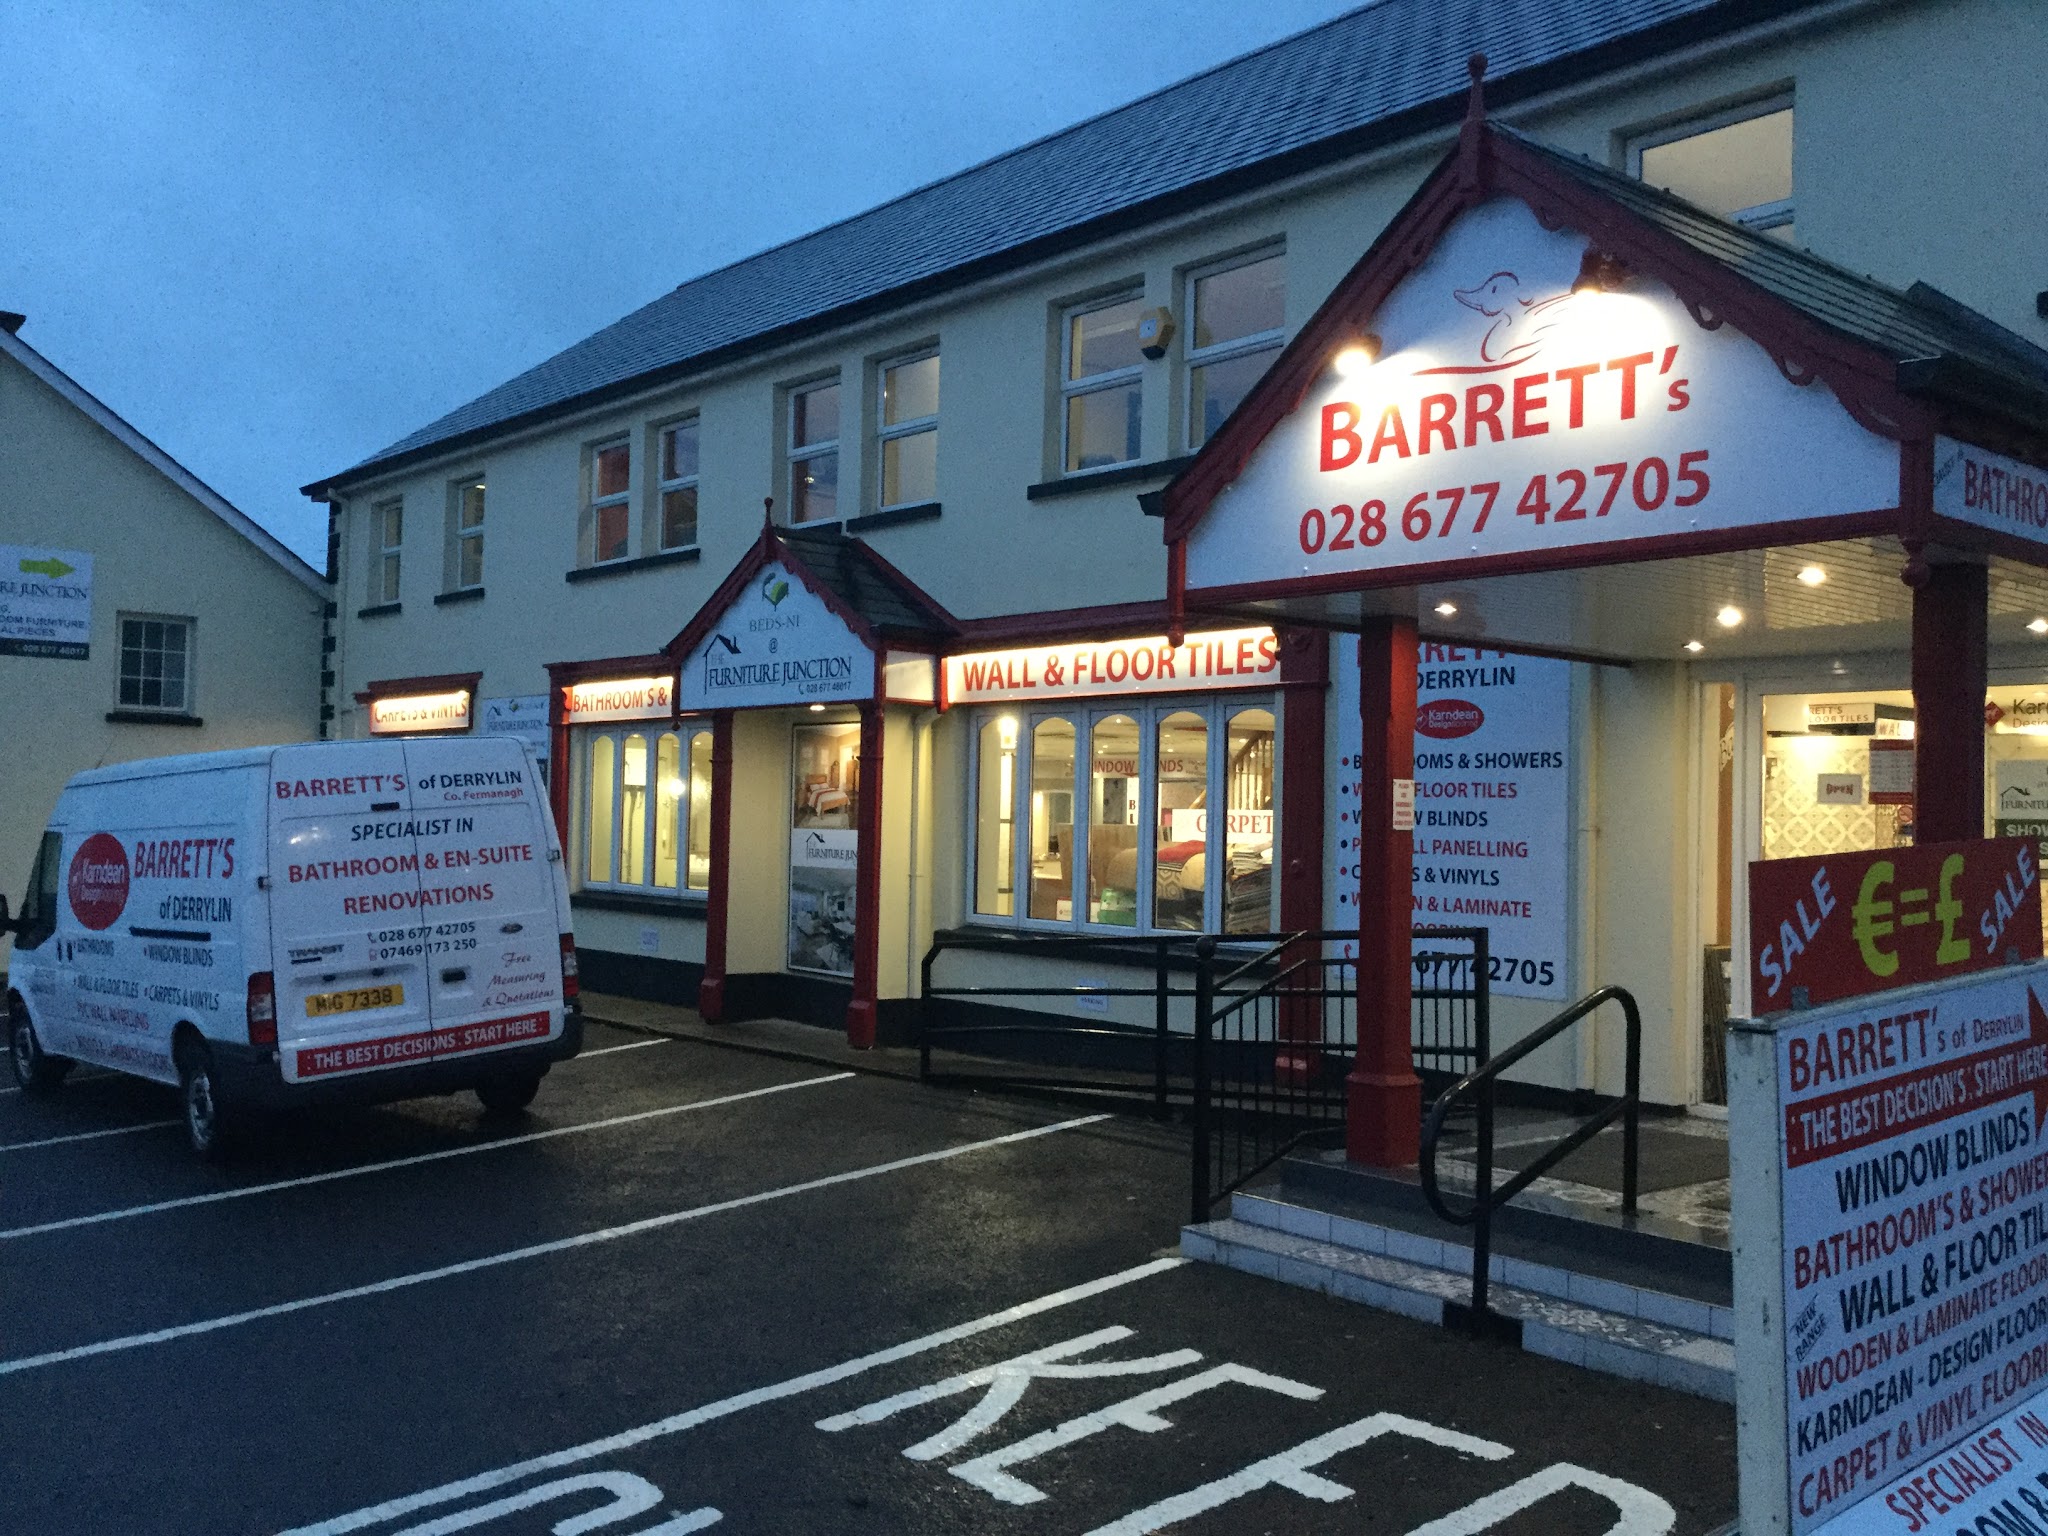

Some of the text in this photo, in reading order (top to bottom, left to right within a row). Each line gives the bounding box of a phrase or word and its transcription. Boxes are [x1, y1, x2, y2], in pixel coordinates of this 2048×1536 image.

[1299, 449, 1712, 556] 028 677 42705
[19, 582, 87, 599] JUNCTION
[750, 614, 800, 633] BEDS-NI
[768, 637, 779, 654] @
[709, 656, 852, 687] FURNITURE JUNCTION
[962, 635, 1278, 692] WALL & FLOOR TILES
[573, 687, 668, 713] BATHROOM'S &
[1428, 709, 1479, 721] Karndean
[1840, 713, 1869, 724] TILES
[1093, 759, 1136, 774] INDOW
[1458, 752, 1471, 768] &
[1474, 752, 1563, 769] SHOWERS
[275, 770, 522, 800] BARRETT'S of DERRYLIN
[444, 787, 524, 801] Co. Fermanagh
[1414, 782, 1518, 799] FLOOR TILES
[351, 817, 474, 841] SPECIALIST IN
[1196, 814, 1274, 834] CRPET
[1427, 811, 1488, 827] BLINDS
[134, 838, 235, 879] BARRETT'S
[808, 847, 845, 860] FURNITURE
[1432, 839, 1528, 859] PANELLING
[288, 844, 534, 884] BATHROOM & EN-SUITE
[1424, 868, 1437, 883] &
[1440, 868, 1500, 887] VINYLS
[159, 895, 233, 922] of DERRYLIN
[344, 883, 494, 915] RENOVATIONS
[1427, 896, 1440, 912] &
[1443, 897, 1532, 918] LAMINATE
[1759, 866, 1836, 997] SALE
[1980, 843, 2036, 954] SALE
[379, 921, 476, 943] 028 677 42705
[183, 947, 214, 967] BLINDS
[380, 937, 477, 960] 07469 173 250
[501, 951, 532, 966] Free
[487, 970, 546, 988] Measuring
[1470, 956, 1555, 986] 2705
[350, 988, 393, 1010] 7338
[494, 988, 555, 1007] Quotations
[1952, 1022, 1966, 1049] of
[1973, 1013, 2024, 1043] DERRYLIN
[315, 1050, 343, 1070] THE
[346, 1045, 380, 1065] BEST
[464, 1024, 502, 1045] START
[1800, 1106, 1837, 1151] THE
[1840, 1093, 1880, 1139] BEST
[1974, 1053, 2014, 1098] START
[1834, 1106, 2030, 1214] WINDOW BLINDS
[1794, 1192, 1955, 1290] BATHROOM'S
[1960, 1185, 1974, 1224] &
[1839, 1264, 1915, 1333] WALL
[1921, 1252, 1939, 1298] &
[1945, 1216, 2017, 1288] FLOOR
[1796, 1328, 1892, 1400] WOODEN
[1896, 1321, 1910, 1355] &
[1913, 1278, 1997, 1345] LAMINATE
[1797, 1366, 1914, 1457] KARNDEAN
[1928, 1324, 1993, 1388] DESIGN
[1799, 1429, 1892, 1518] CARPET
[1896, 1420, 1913, 1460] &
[1916, 1384, 1978, 1447] VINYL
[1885, 1427, 2023, 1533] SPECIALIST
